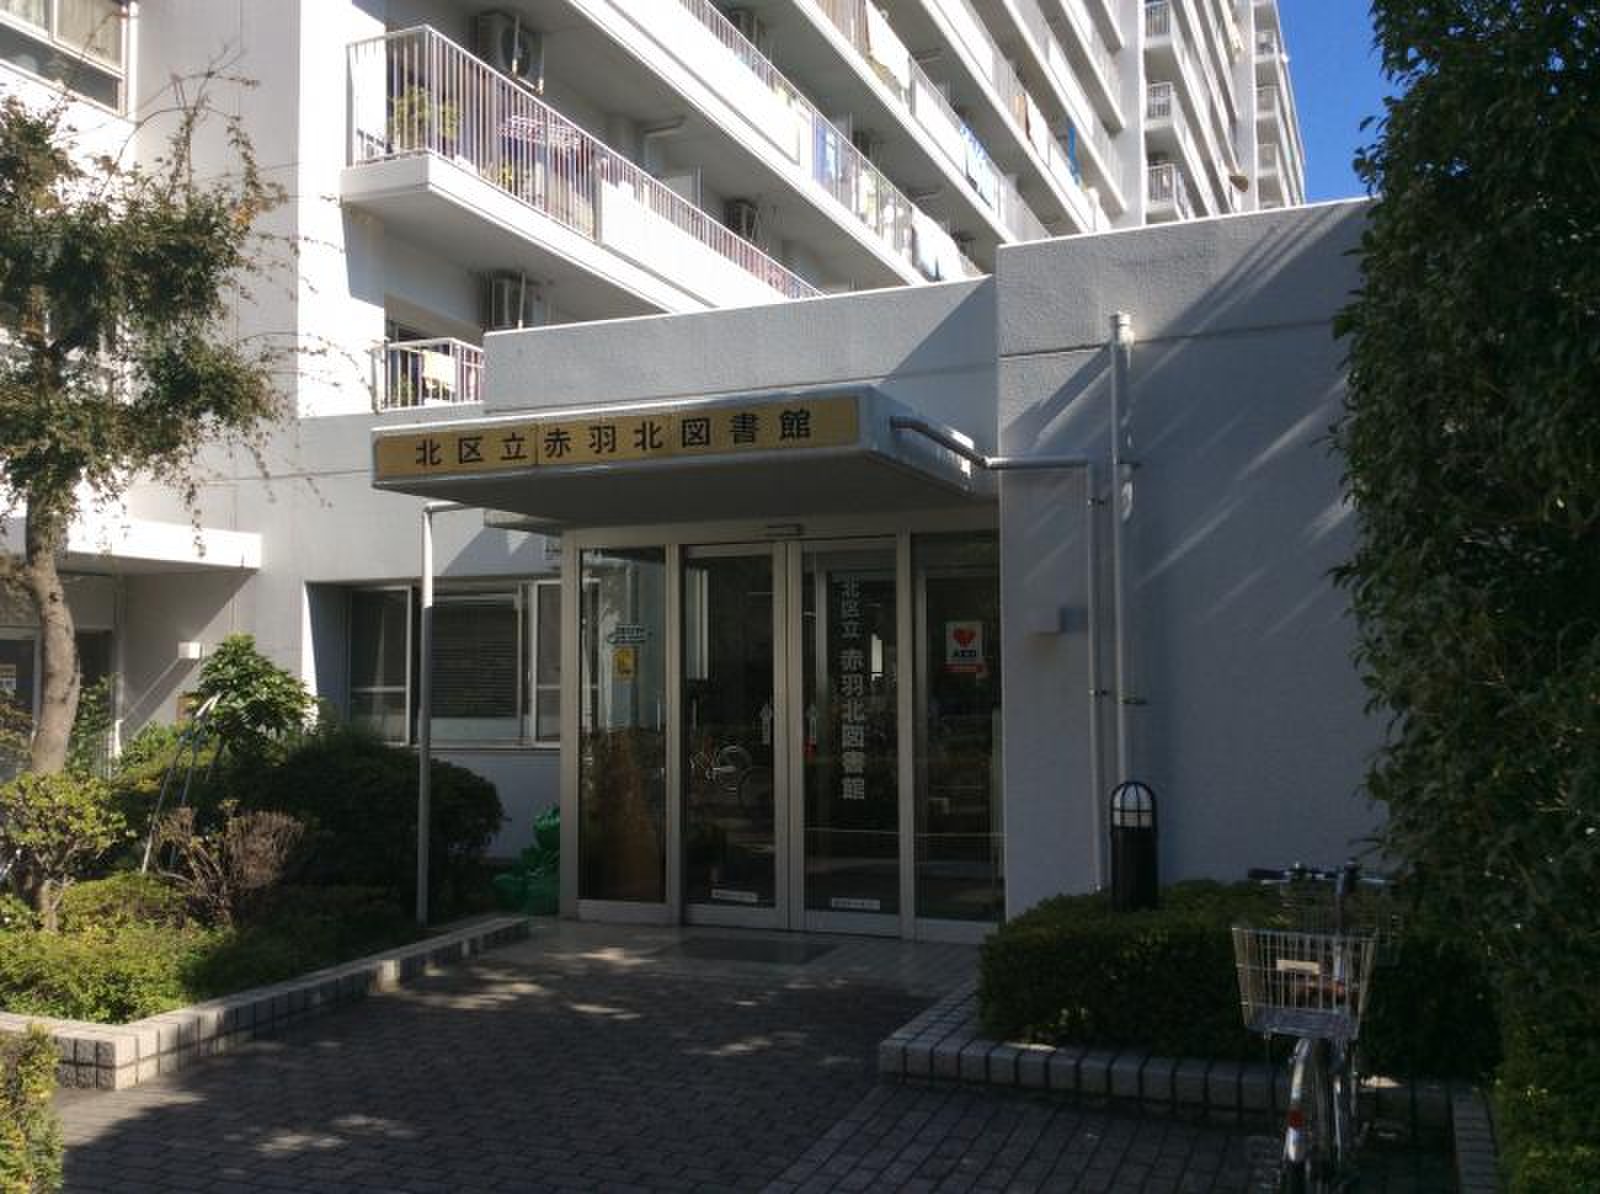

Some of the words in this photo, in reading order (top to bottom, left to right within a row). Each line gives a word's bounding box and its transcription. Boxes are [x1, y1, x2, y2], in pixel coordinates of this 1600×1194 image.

[414, 409, 812, 465] 北区立赤羽北図書館
